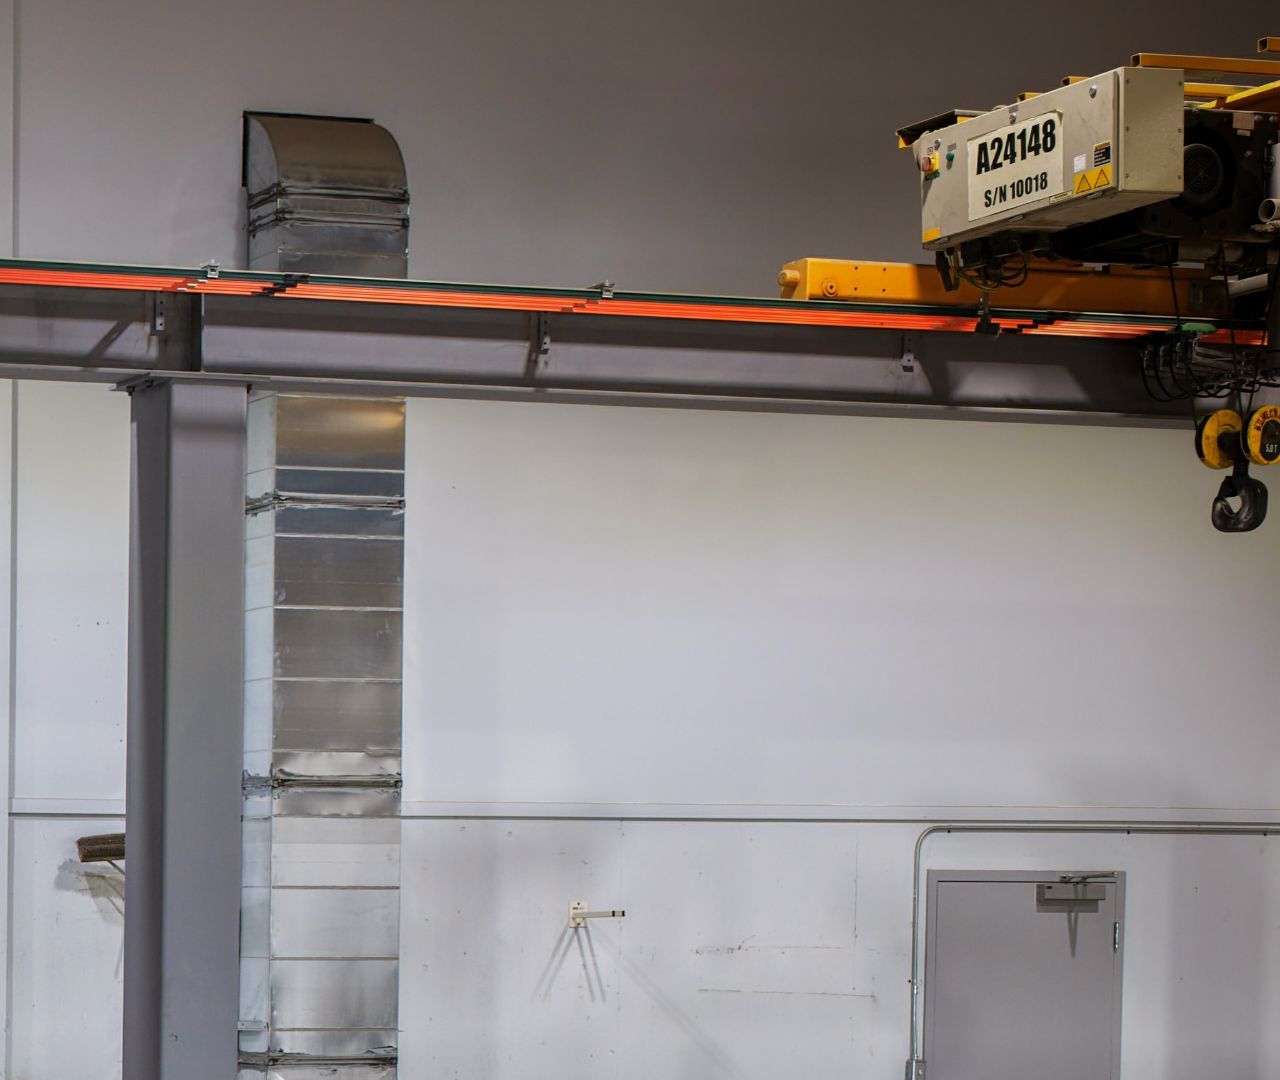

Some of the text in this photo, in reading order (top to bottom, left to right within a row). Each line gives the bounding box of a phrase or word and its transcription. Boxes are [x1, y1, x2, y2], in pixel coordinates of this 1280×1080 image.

[976, 118, 1056, 175] A24148
[984, 184, 1007, 208] S/N
[1010, 171, 1048, 199] 10018
